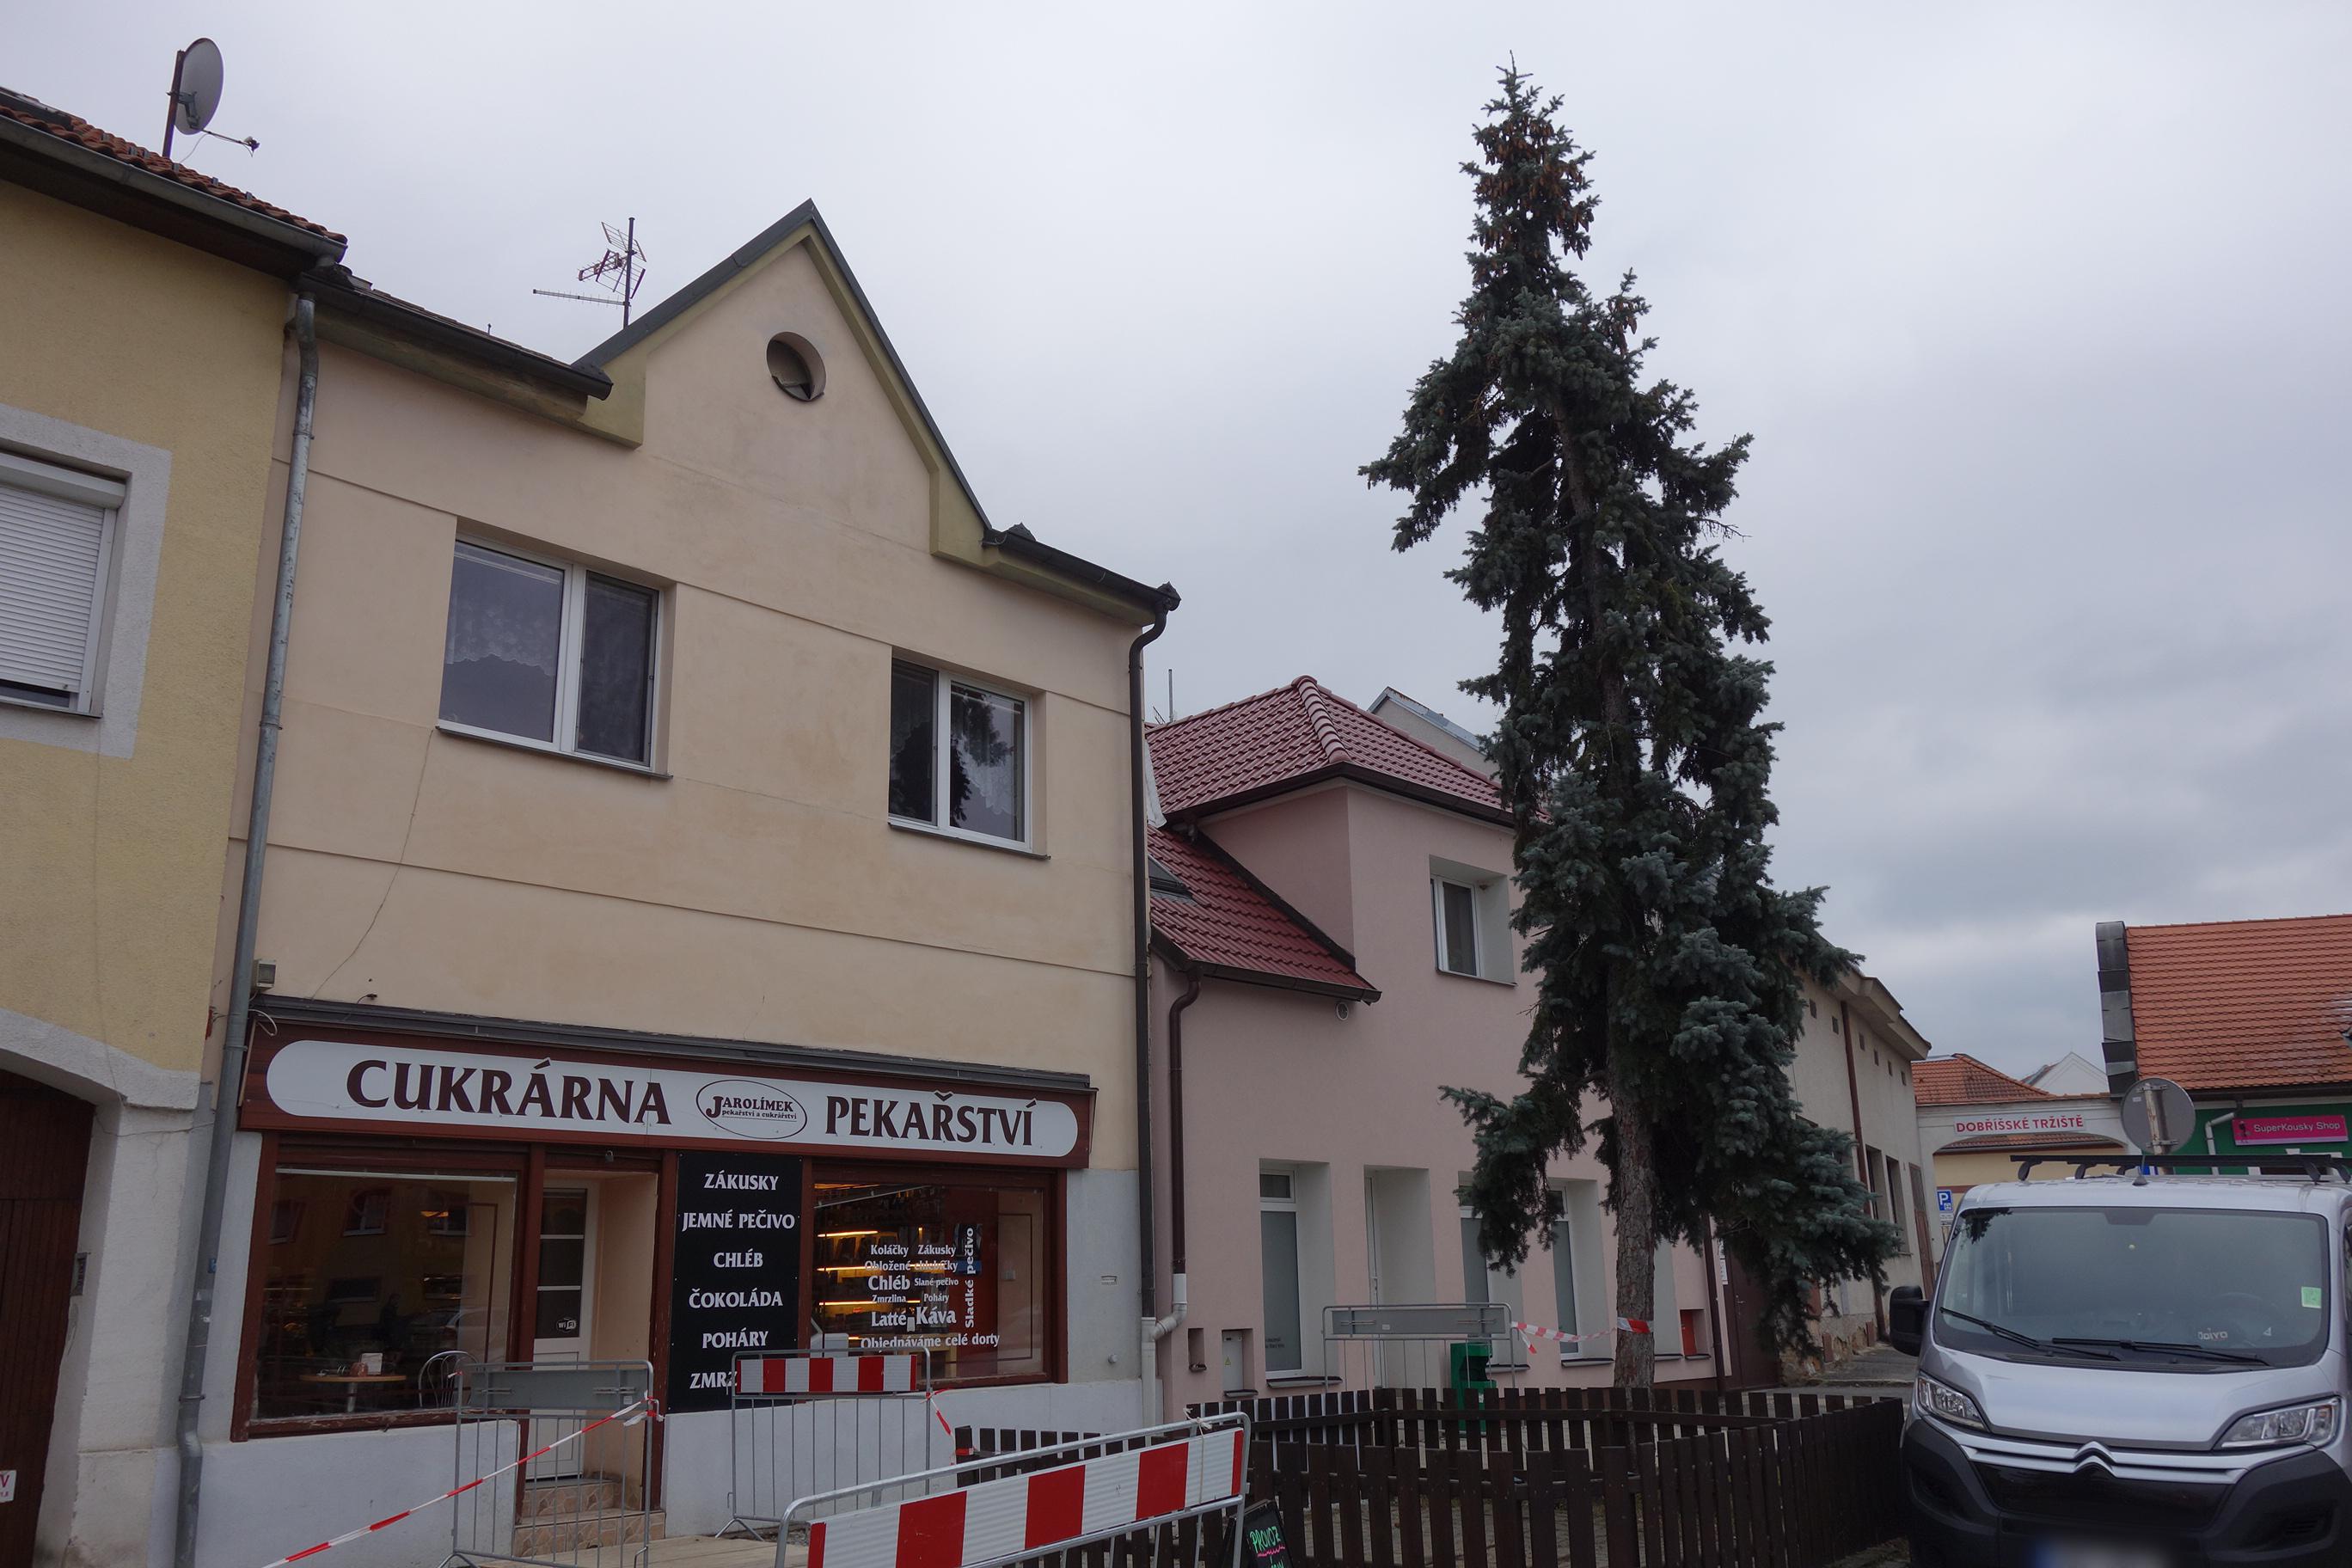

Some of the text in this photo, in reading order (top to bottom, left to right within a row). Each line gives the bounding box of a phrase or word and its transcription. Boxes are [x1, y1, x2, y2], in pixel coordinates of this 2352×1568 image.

[346, 1057, 672, 1125] CUKRÁRNA
[706, 1096, 793, 1118] JAROLÍMEK
[826, 1091, 1038, 1147] PEKAŘSTVÍ
[1957, 1115, 2084, 1133] DOBŘÍŠSKÉ TRŽIŠTĚ
[2253, 1122, 2341, 1133] SuperKousky Shop
[704, 1170, 779, 1191] ZÁKUSKY
[1939, 1192, 1949, 1206] P
[682, 1209, 795, 1232] JEMNÉ PEČIVO
[714, 1248, 763, 1268] CHLÉB
[870, 1244, 956, 1258] Koláčky Zákusky
[865, 1260, 911, 1271] Obložené
[868, 1275, 911, 1290] Chléb
[914, 1277, 959, 1288] Slané pečivo
[965, 1227, 976, 1328] Sladké pečivo
[689, 1288, 783, 1309] ČOKOLÁDA
[872, 1294, 907, 1303] Zmrzlina
[923, 1293, 950, 1304] Poháry
[871, 1310, 907, 1327] Latté
[916, 1306, 957, 1325] Káva
[702, 1327, 769, 1349] POHÁRY
[861, 1332, 1000, 1351] Objednáváme celé dorty
